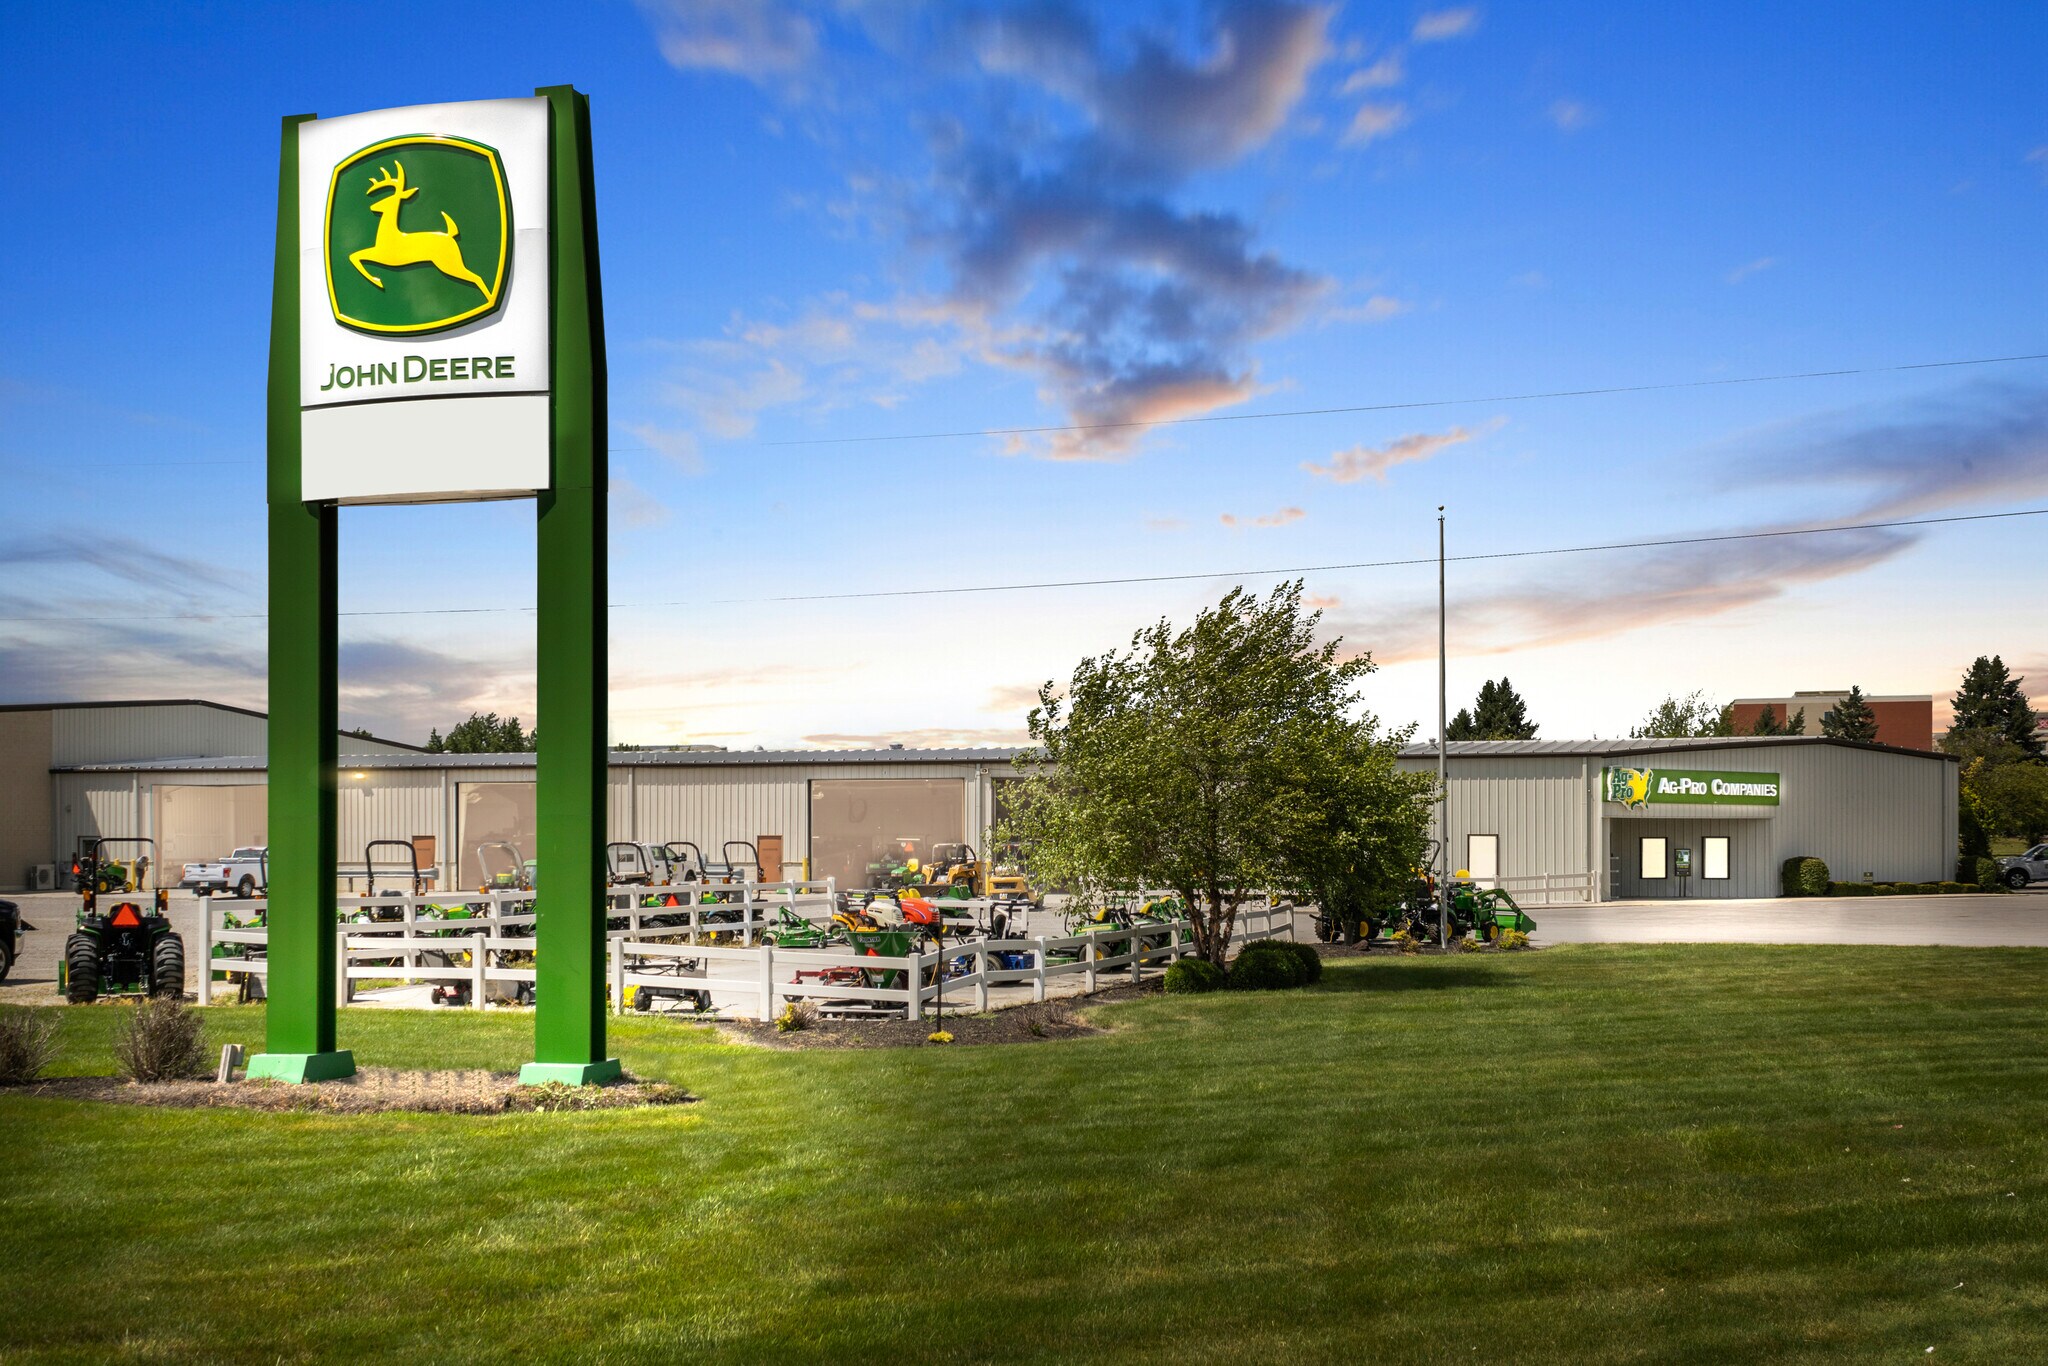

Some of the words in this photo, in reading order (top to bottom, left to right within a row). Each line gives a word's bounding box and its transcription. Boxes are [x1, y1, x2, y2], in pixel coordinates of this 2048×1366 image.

[320, 362, 397, 391] JOHN
[404, 355, 515, 383] DEERE
[1711, 778, 1777, 797] COMPANIES
